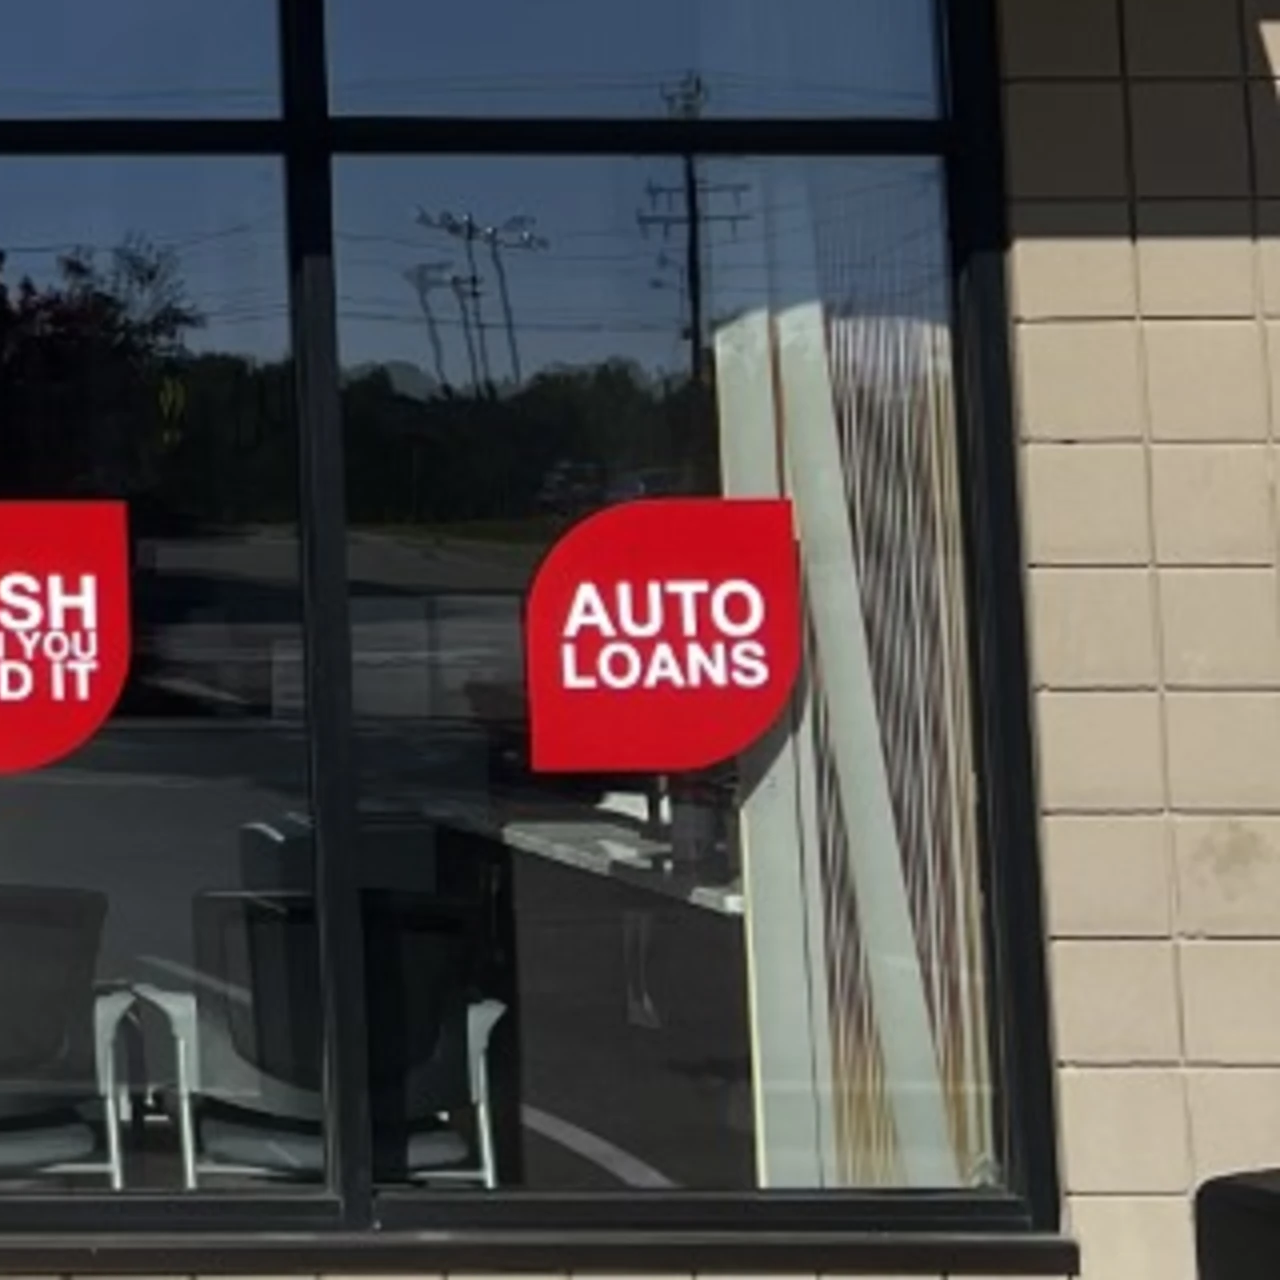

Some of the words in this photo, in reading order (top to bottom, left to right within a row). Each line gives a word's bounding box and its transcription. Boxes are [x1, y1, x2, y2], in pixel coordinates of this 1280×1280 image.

[562, 579, 766, 638] AUTO
[16, 631, 98, 661] YOU
[561, 641, 770, 689] LOANS
[50, 660, 98, 701] IT
